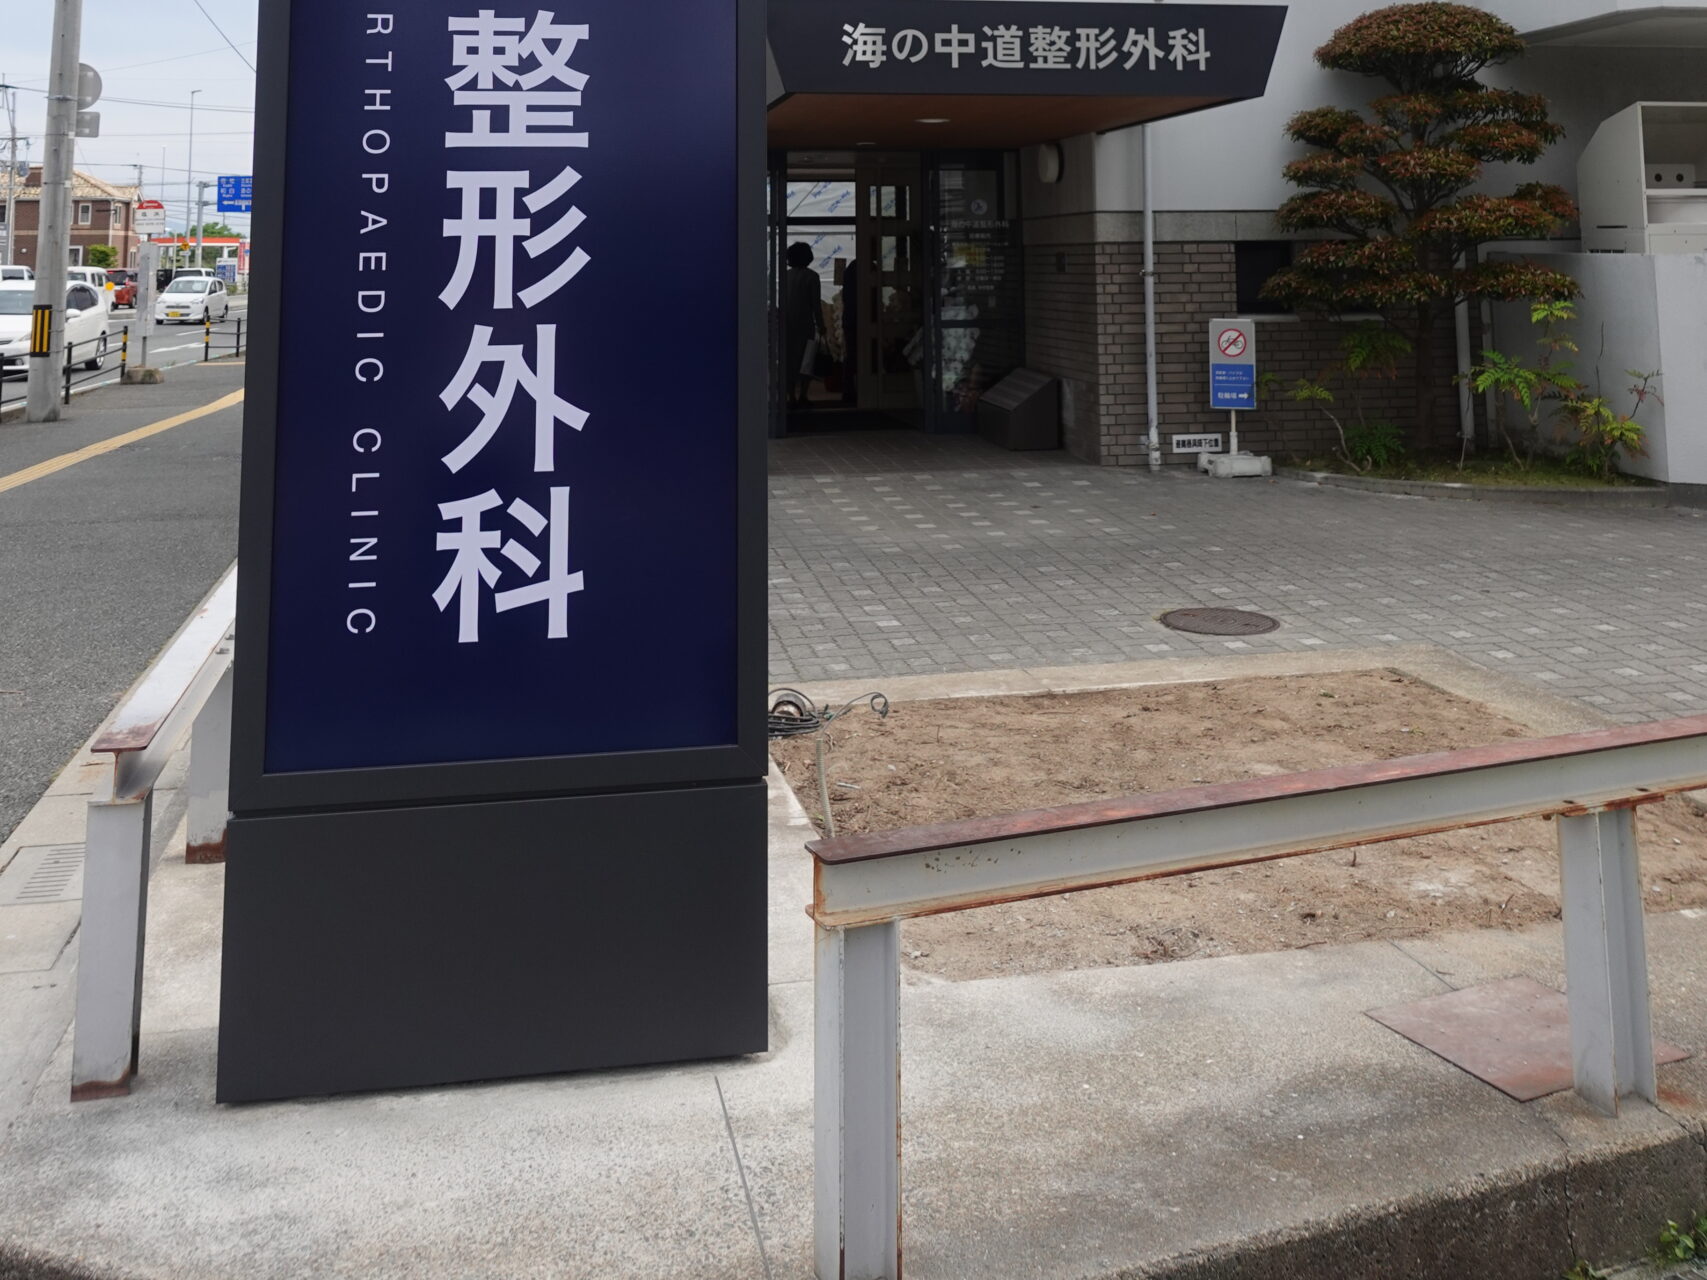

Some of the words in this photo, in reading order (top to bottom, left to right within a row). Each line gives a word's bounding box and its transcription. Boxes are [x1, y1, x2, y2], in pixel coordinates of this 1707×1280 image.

[841, 22, 1212, 71] 海の中道整形外科
[346, 427, 382, 635] CLINIC
